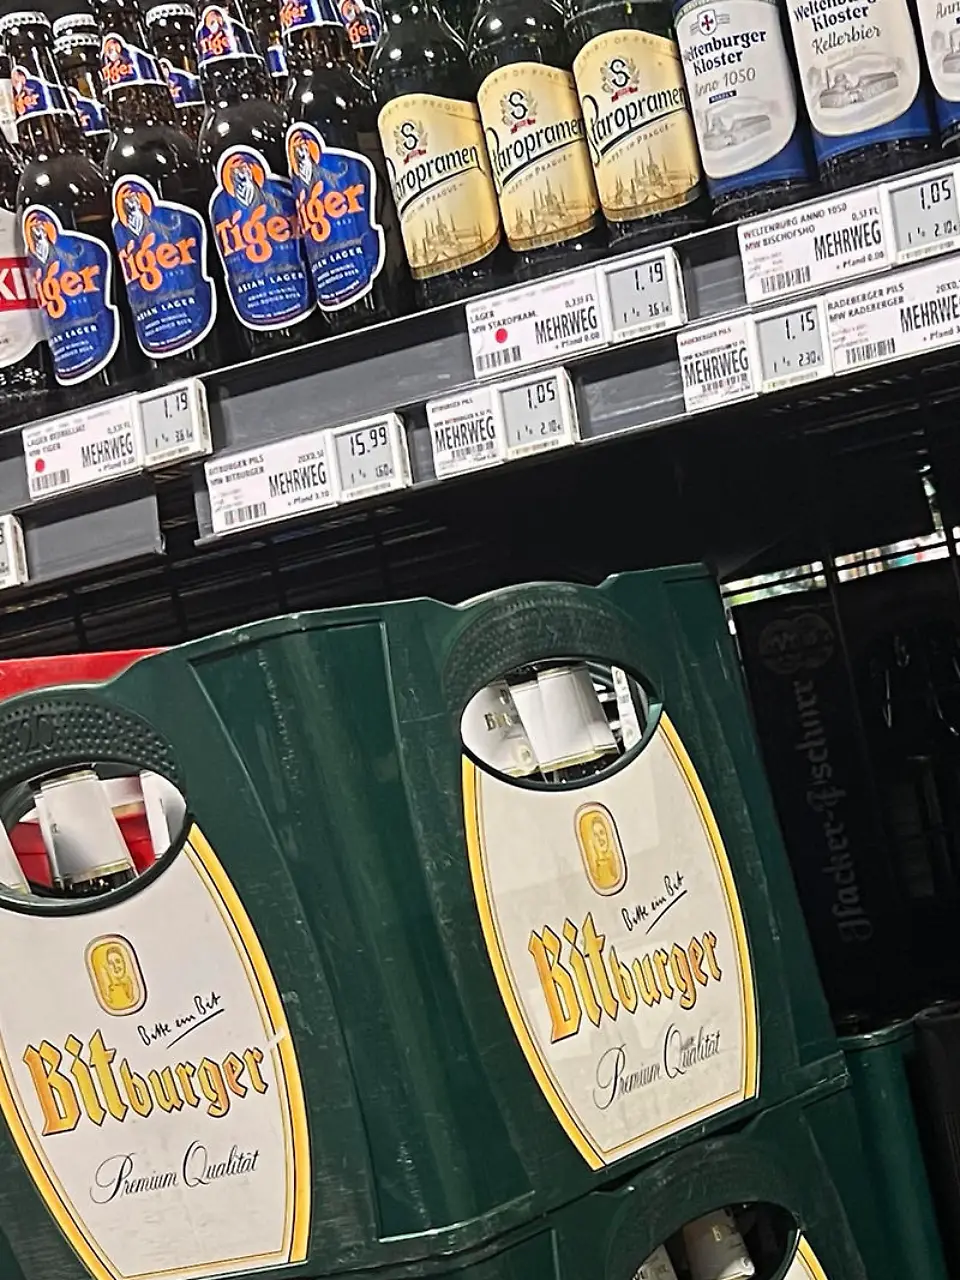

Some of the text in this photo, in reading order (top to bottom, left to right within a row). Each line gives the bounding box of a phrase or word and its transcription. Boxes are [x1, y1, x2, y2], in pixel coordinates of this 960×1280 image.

[812, 5, 869, 32] Kloster
[812, 25, 881, 55] Kellerbier
[693, 49, 744, 77] Kloster
[722, 67, 756, 87] 1050
[919, 179, 952, 211] 1.05
[813, 220, 882, 262] MEHRWEG
[634, 262, 663, 291] 1.19
[534, 306, 598, 345] MEHRWEG
[785, 311, 815, 341] 1.15
[683, 347, 749, 387] MEHRWEG
[164, 392, 188, 418] 1.19
[526, 382, 556, 411] 1.05
[81, 433, 133, 468] MEHRWEG
[350, 426, 387, 457] 15.99
[434, 416, 496, 452] MEHRWEG
[268, 463, 327, 499] MEHRWEG
[527, 911, 723, 1044] Bitburger
[22, 1029, 269, 1137] Bitburger
[593, 1023, 721, 1111] Premium Qualität
[90, 1140, 261, 1204] Premium Qualität
